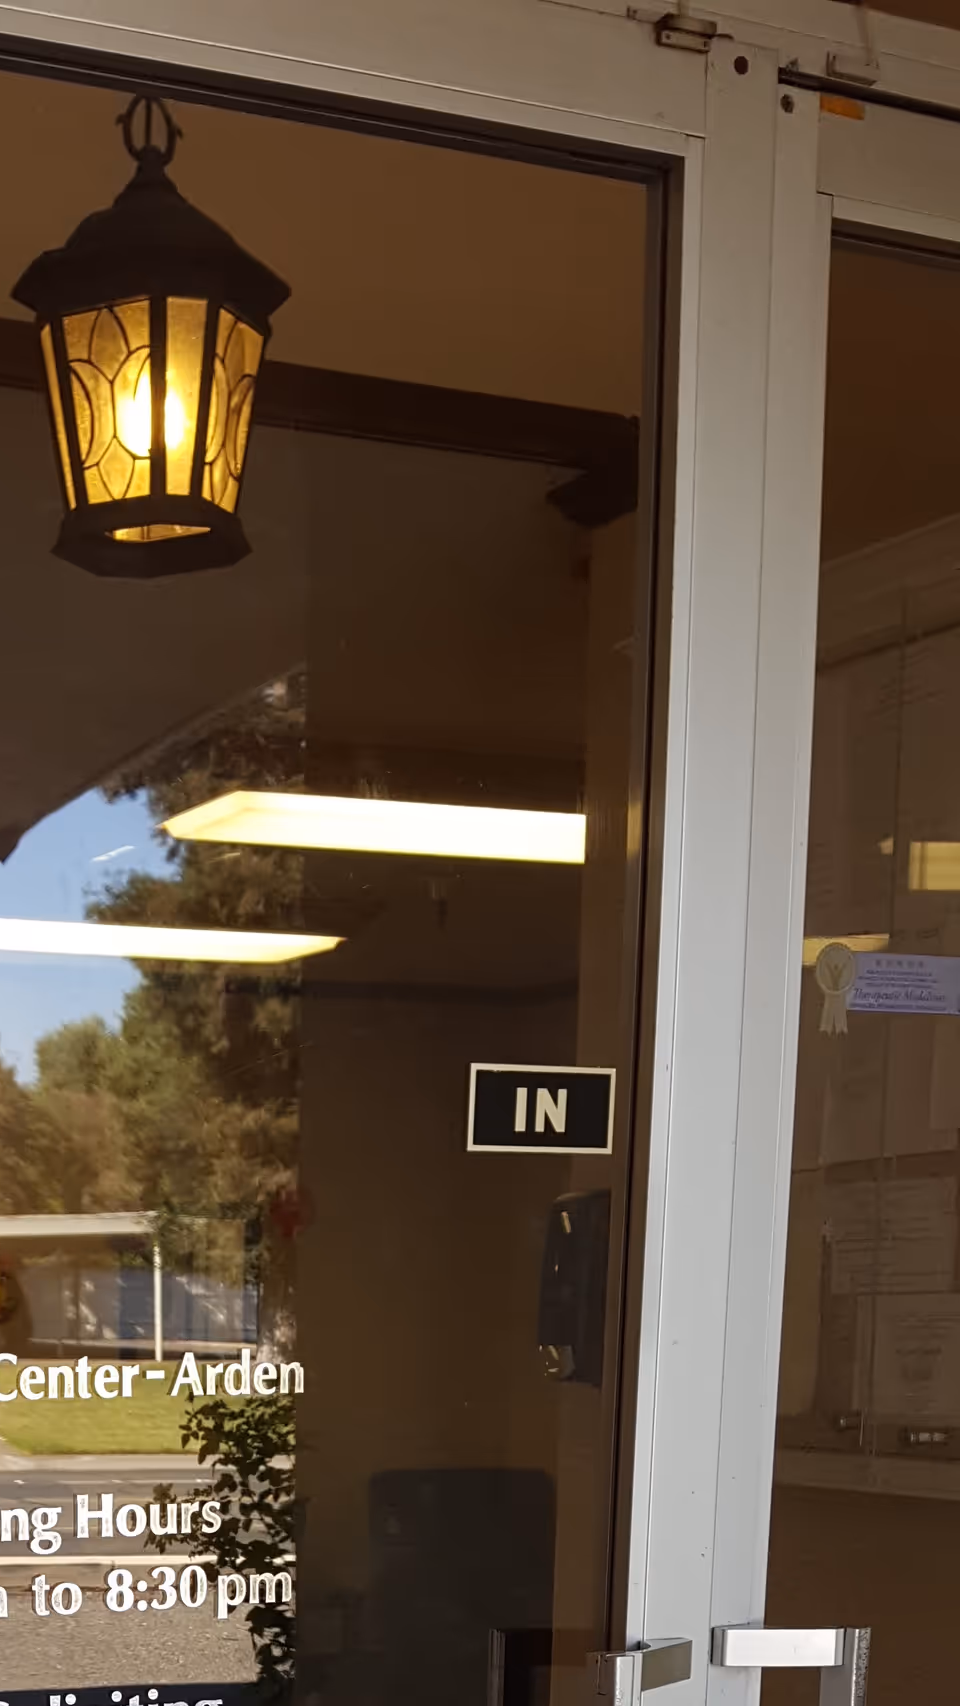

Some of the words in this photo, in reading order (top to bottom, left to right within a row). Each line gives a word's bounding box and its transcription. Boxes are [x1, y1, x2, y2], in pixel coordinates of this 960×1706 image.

[514, 1087, 567, 1133] IN
[74, 1493, 222, 1539] Hours
[32, 1574, 82, 1616] to
